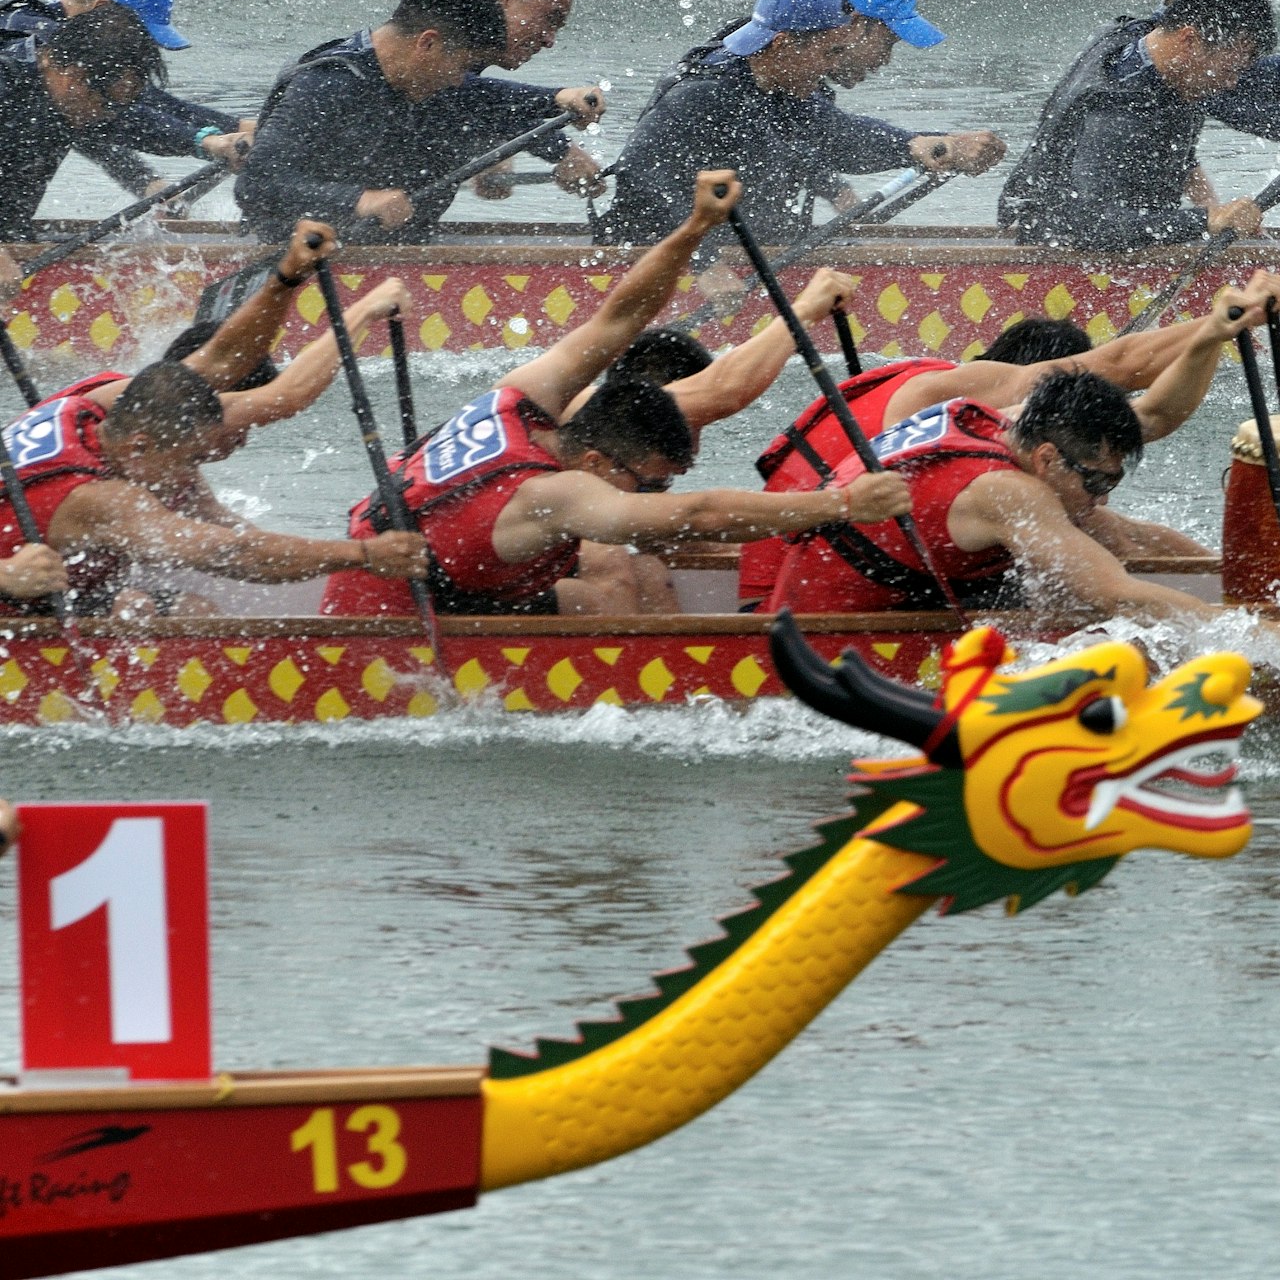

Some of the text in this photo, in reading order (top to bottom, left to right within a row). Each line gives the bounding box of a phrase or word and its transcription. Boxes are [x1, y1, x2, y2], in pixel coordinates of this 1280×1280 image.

[50, 817, 172, 1044] 1
[29, 1170, 131, 1205] Racing
[292, 1106, 407, 1193] 13
